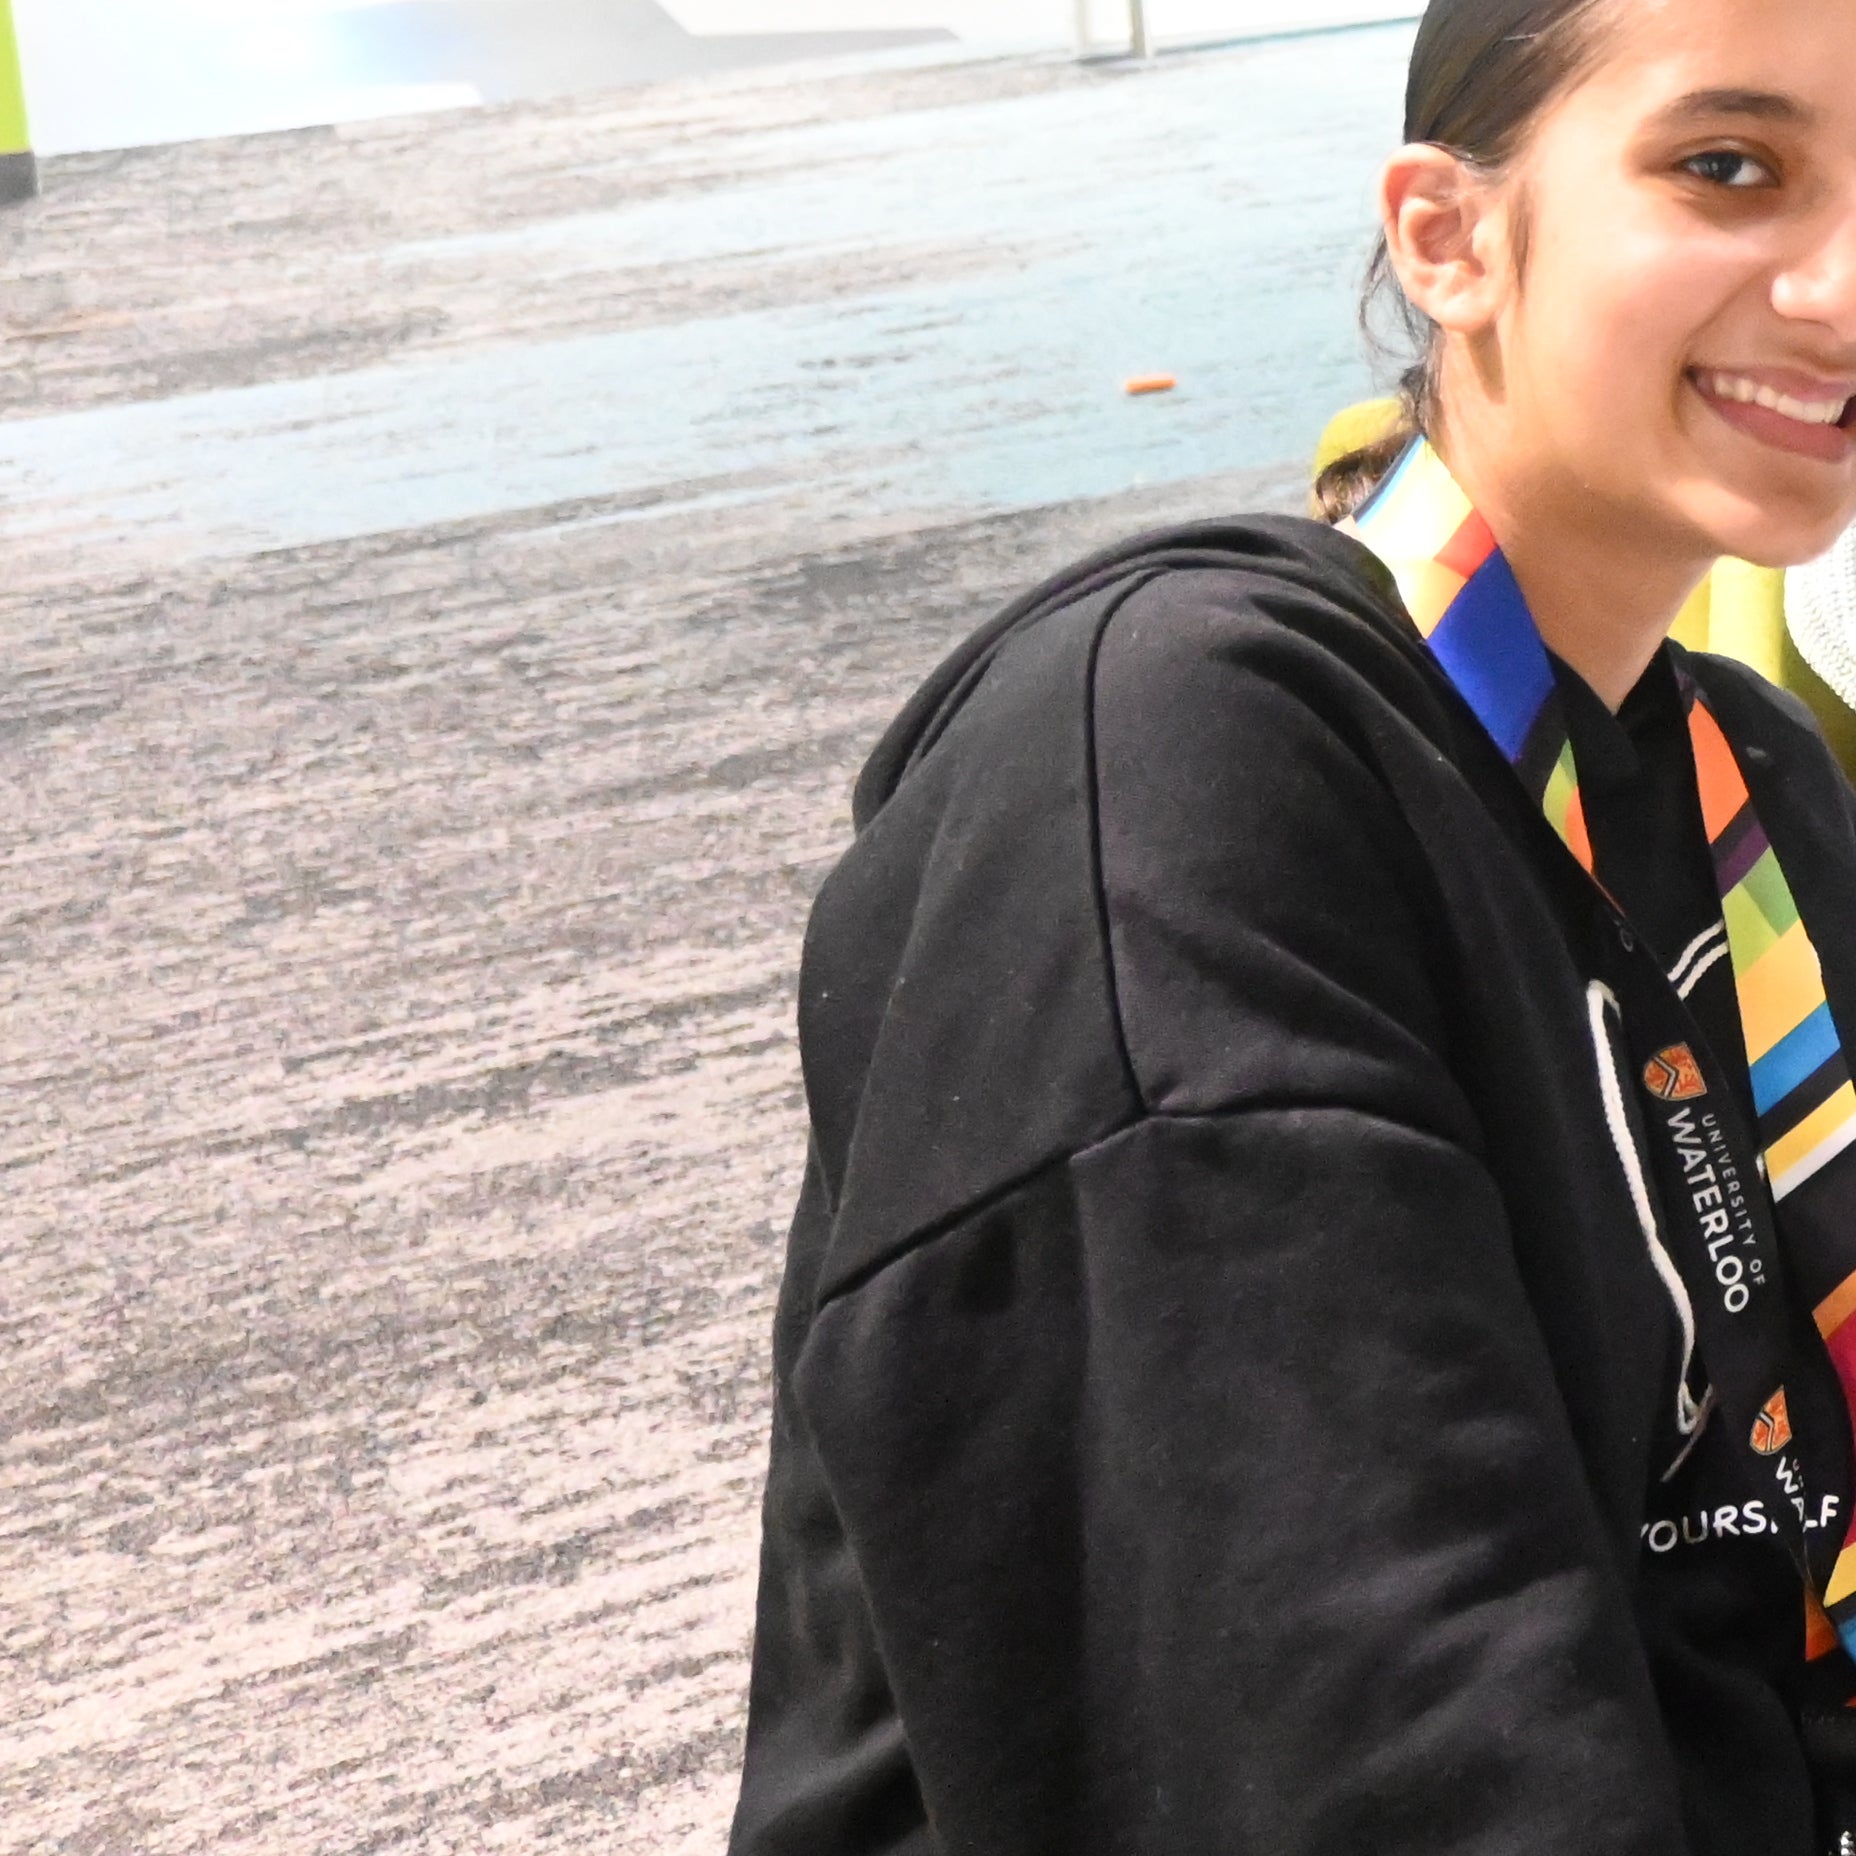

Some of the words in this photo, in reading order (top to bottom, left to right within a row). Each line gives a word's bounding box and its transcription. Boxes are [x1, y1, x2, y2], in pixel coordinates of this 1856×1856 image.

[1666, 1106, 1750, 1313] WATERLOO
[1701, 1113, 1757, 1245] UNIVERSITY
[1749, 1258, 1766, 1286] OF
[1640, 1494, 1840, 1553] OURSF
